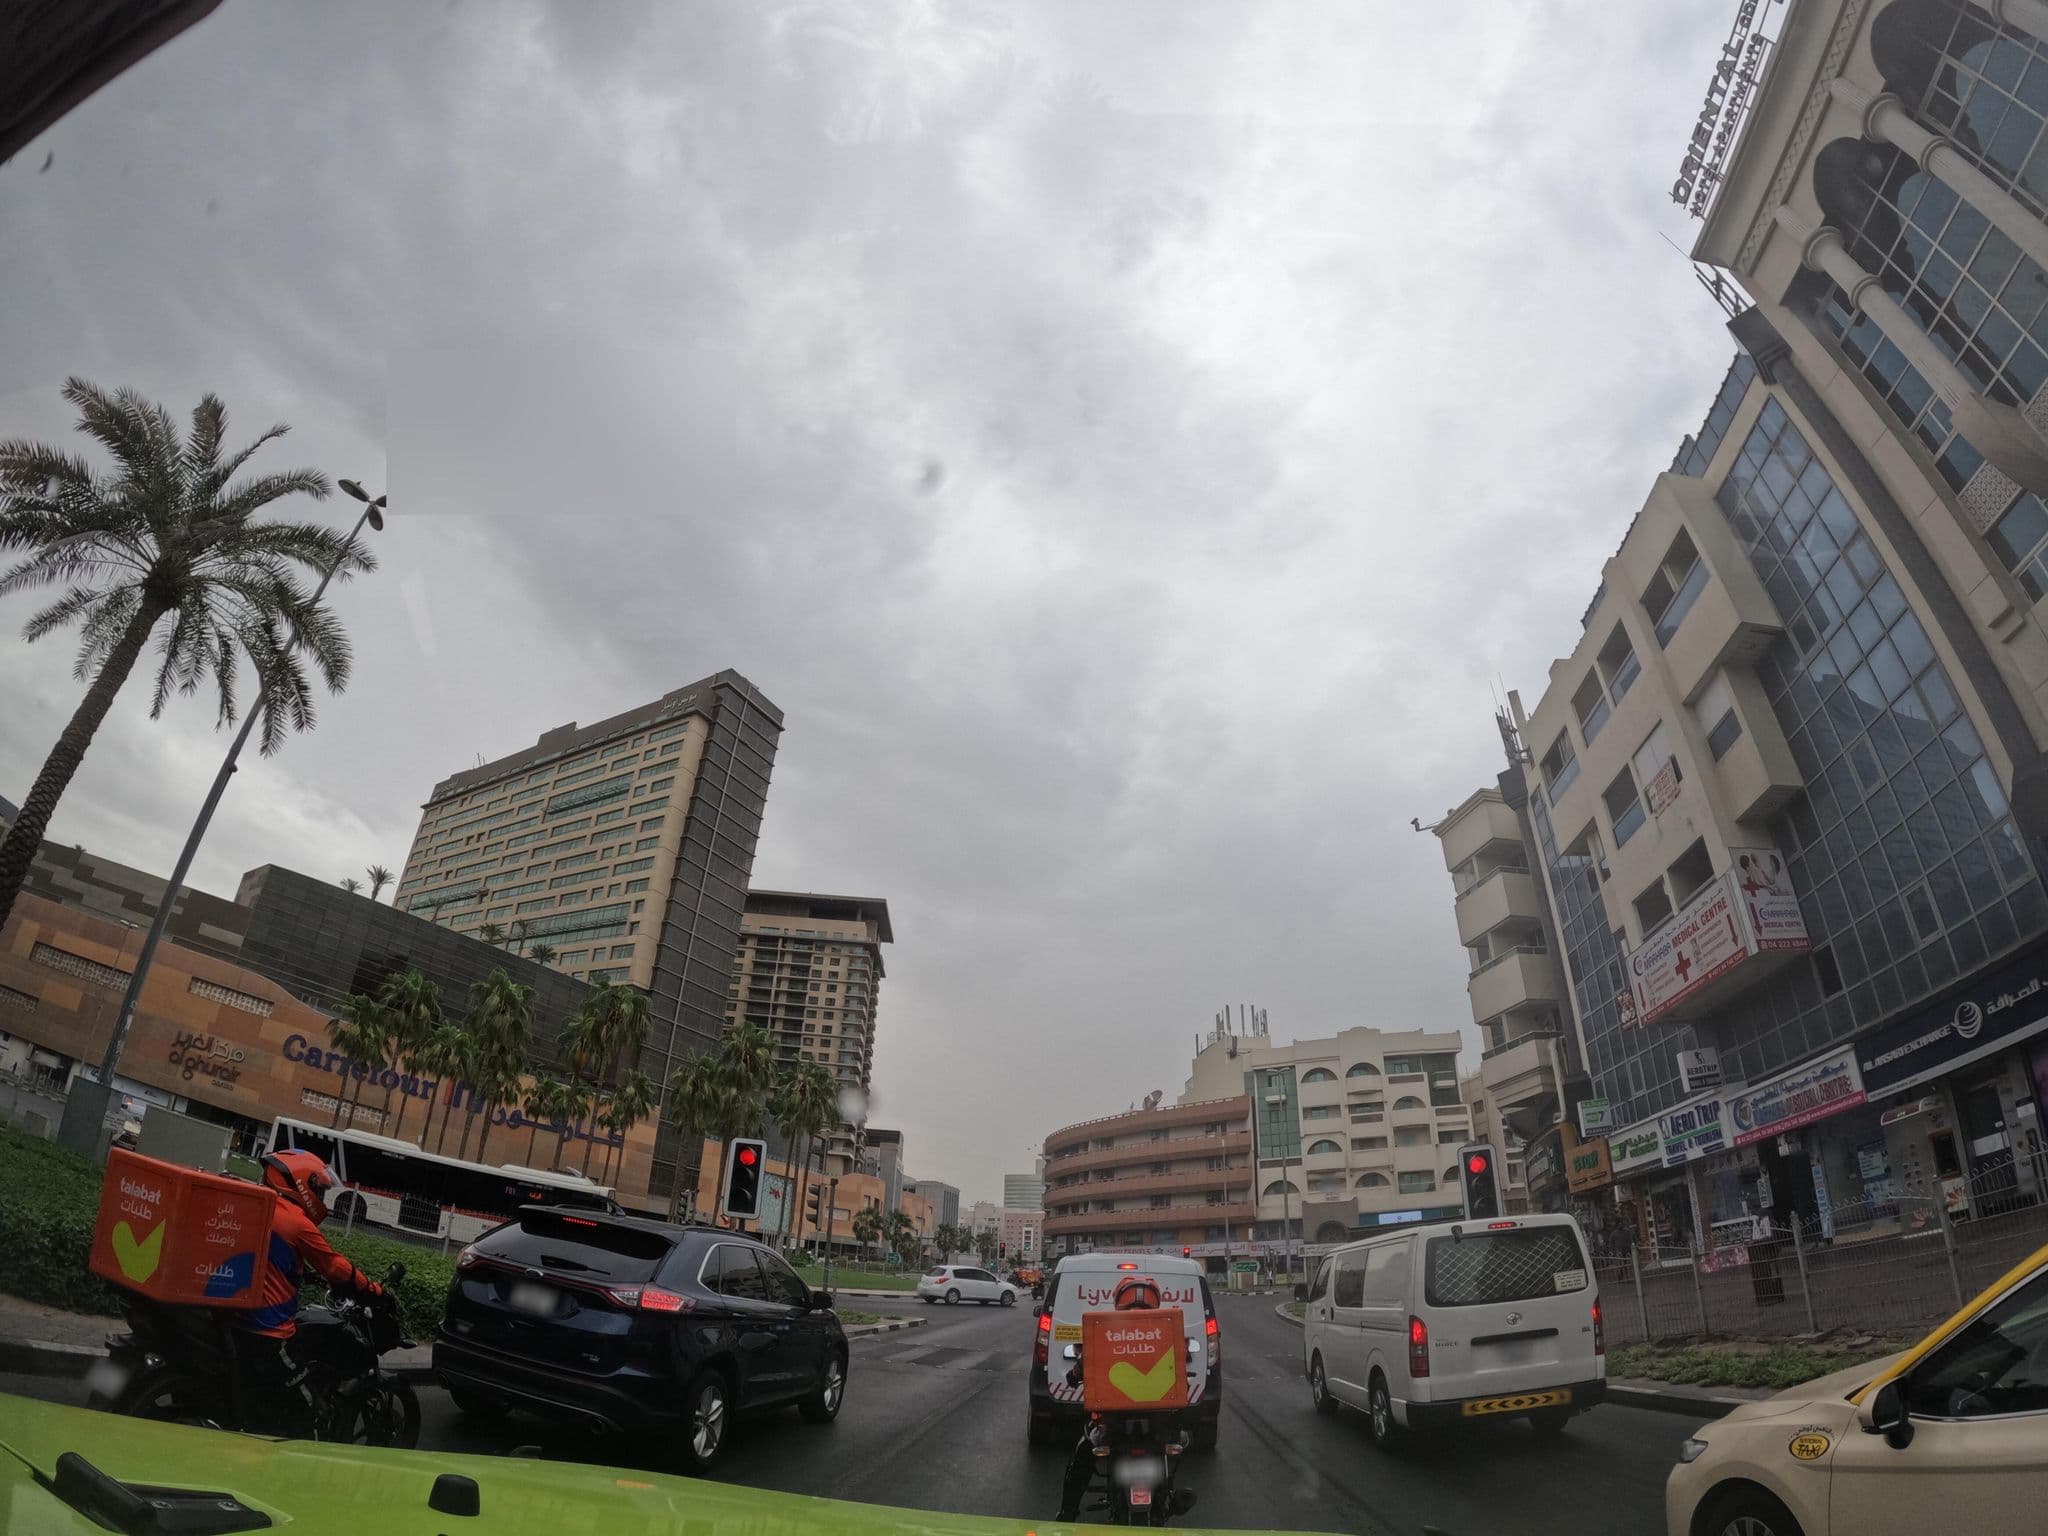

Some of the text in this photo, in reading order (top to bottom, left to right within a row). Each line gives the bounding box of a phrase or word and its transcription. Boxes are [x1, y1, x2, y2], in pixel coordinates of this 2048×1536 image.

[1673, 39, 1742, 204] ORIENTAL
[1688, 33, 1763, 218] HOTEL APARTMENTS
[1669, 920, 1700, 949] MEDICAL
[1699, 897, 1729, 926] CENTRE
[171, 1032, 245, 1063] مركز الغرير
[1904, 1024, 1952, 1053] EXCHANGE
[1670, 1100, 1721, 1136] AERO TRIP
[1665, 1141, 1688, 1156] TRAVEL
[1693, 1128, 1722, 1147] TOURISM
[120, 1178, 161, 1205] talabat
[121, 1200, 152, 1220] طلبات
[195, 1263, 234, 1280] طلبات
[1078, 1285, 1116, 1306] Lyv
[1106, 1328, 1161, 1342] talabat
[1113, 1344, 1155, 1357] طلبات
[1798, 1444, 1821, 1456] TAXI
